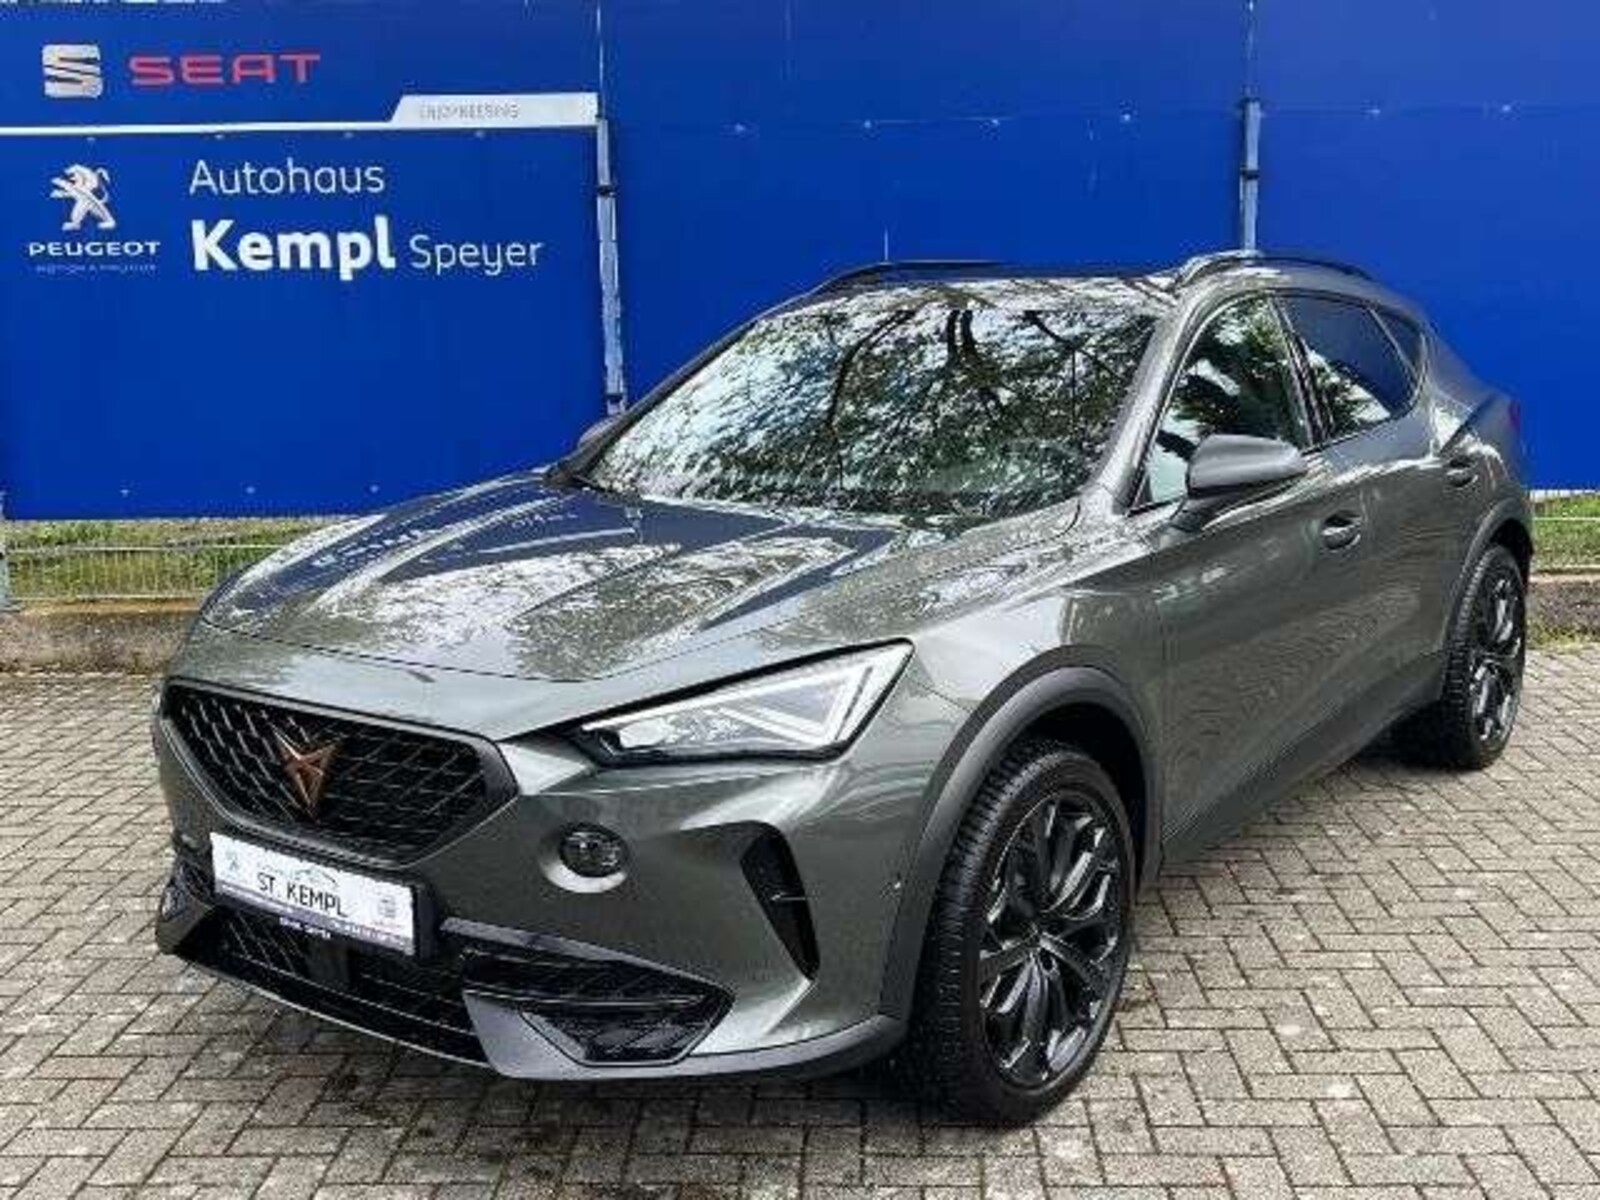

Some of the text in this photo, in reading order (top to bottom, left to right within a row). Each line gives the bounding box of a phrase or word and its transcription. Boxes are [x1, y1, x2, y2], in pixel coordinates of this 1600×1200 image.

[128, 53, 321, 86] SEAT
[189, 157, 385, 195] Autohaus
[28, 241, 161, 257] PEUGEOT
[191, 214, 545, 281] Kempl Speyer
[286, 881, 349, 918] KEMPL
